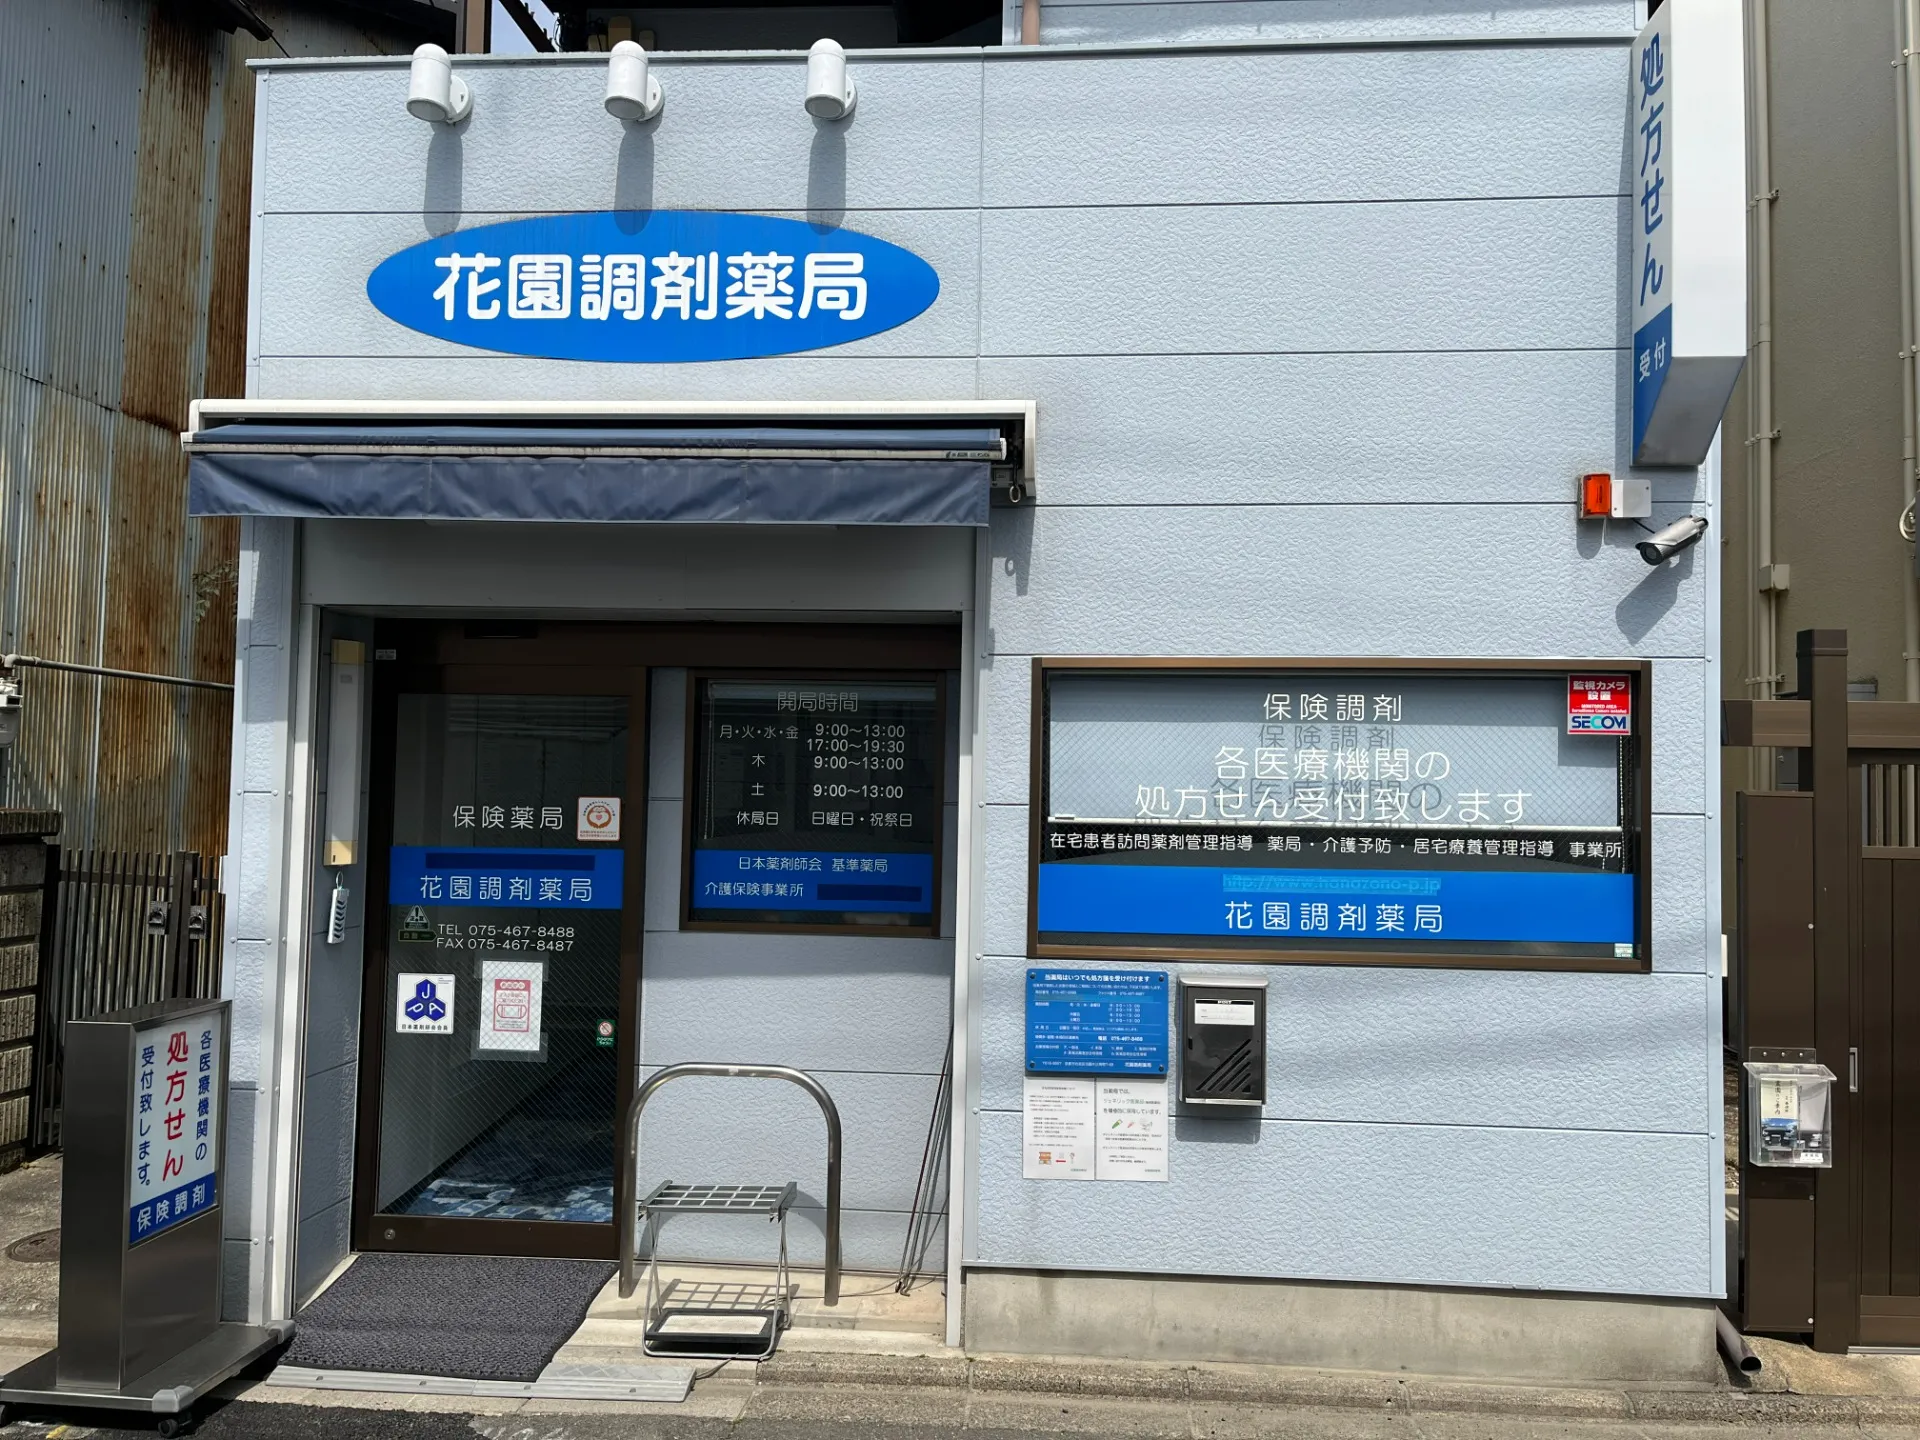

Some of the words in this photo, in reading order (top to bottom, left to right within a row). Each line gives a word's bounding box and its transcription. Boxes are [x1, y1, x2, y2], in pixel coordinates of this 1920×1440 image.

[1639, 32, 1665, 308] 処方せん
[433, 250, 869, 321] 花園調剤薬局
[1638, 336, 1668, 383] 受付
[1573, 680, 1626, 691] 監視カメラ
[1587, 690, 1612, 701] 設置
[776, 691, 859, 713] 開局時間
[1263, 692, 1403, 722] 保険調剤
[1571, 715, 1627, 730] SECOM
[751, 753, 766, 768] 木
[1213, 746, 1451, 782] 各医療機関の
[750, 782, 765, 797] 土
[452, 804, 564, 830] 保険薬局
[1134, 784, 1533, 824] 処方せん受付致します
[736, 811, 780, 826] 休局日
[811, 812, 913, 828] 日曜日・祝祭日
[1049, 831, 1254, 852] 在宅患者訪問薬剤管理指導
[1569, 841, 1622, 859] 事業所
[738, 856, 822, 871] 日本薬剤師会
[831, 857, 888, 873] 基準薬局
[419, 875, 592, 902] 花園調剤薬局
[704, 881, 804, 897] 介護保険事業所
[437, 923, 462, 935] TEL
[468, 924, 575, 938] 075-467-8488
[1224, 900, 1443, 934] 花園調剤薬局
[436, 937, 464, 950] FAX
[467, 938, 574, 952] 075-467-8487
[162, 1030, 189, 1183] 処方せん
[195, 1029, 213, 1162] 各医療機関の
[137, 1047, 155, 1187] 受付致します。
[137, 1183, 206, 1232] 保険調剤
